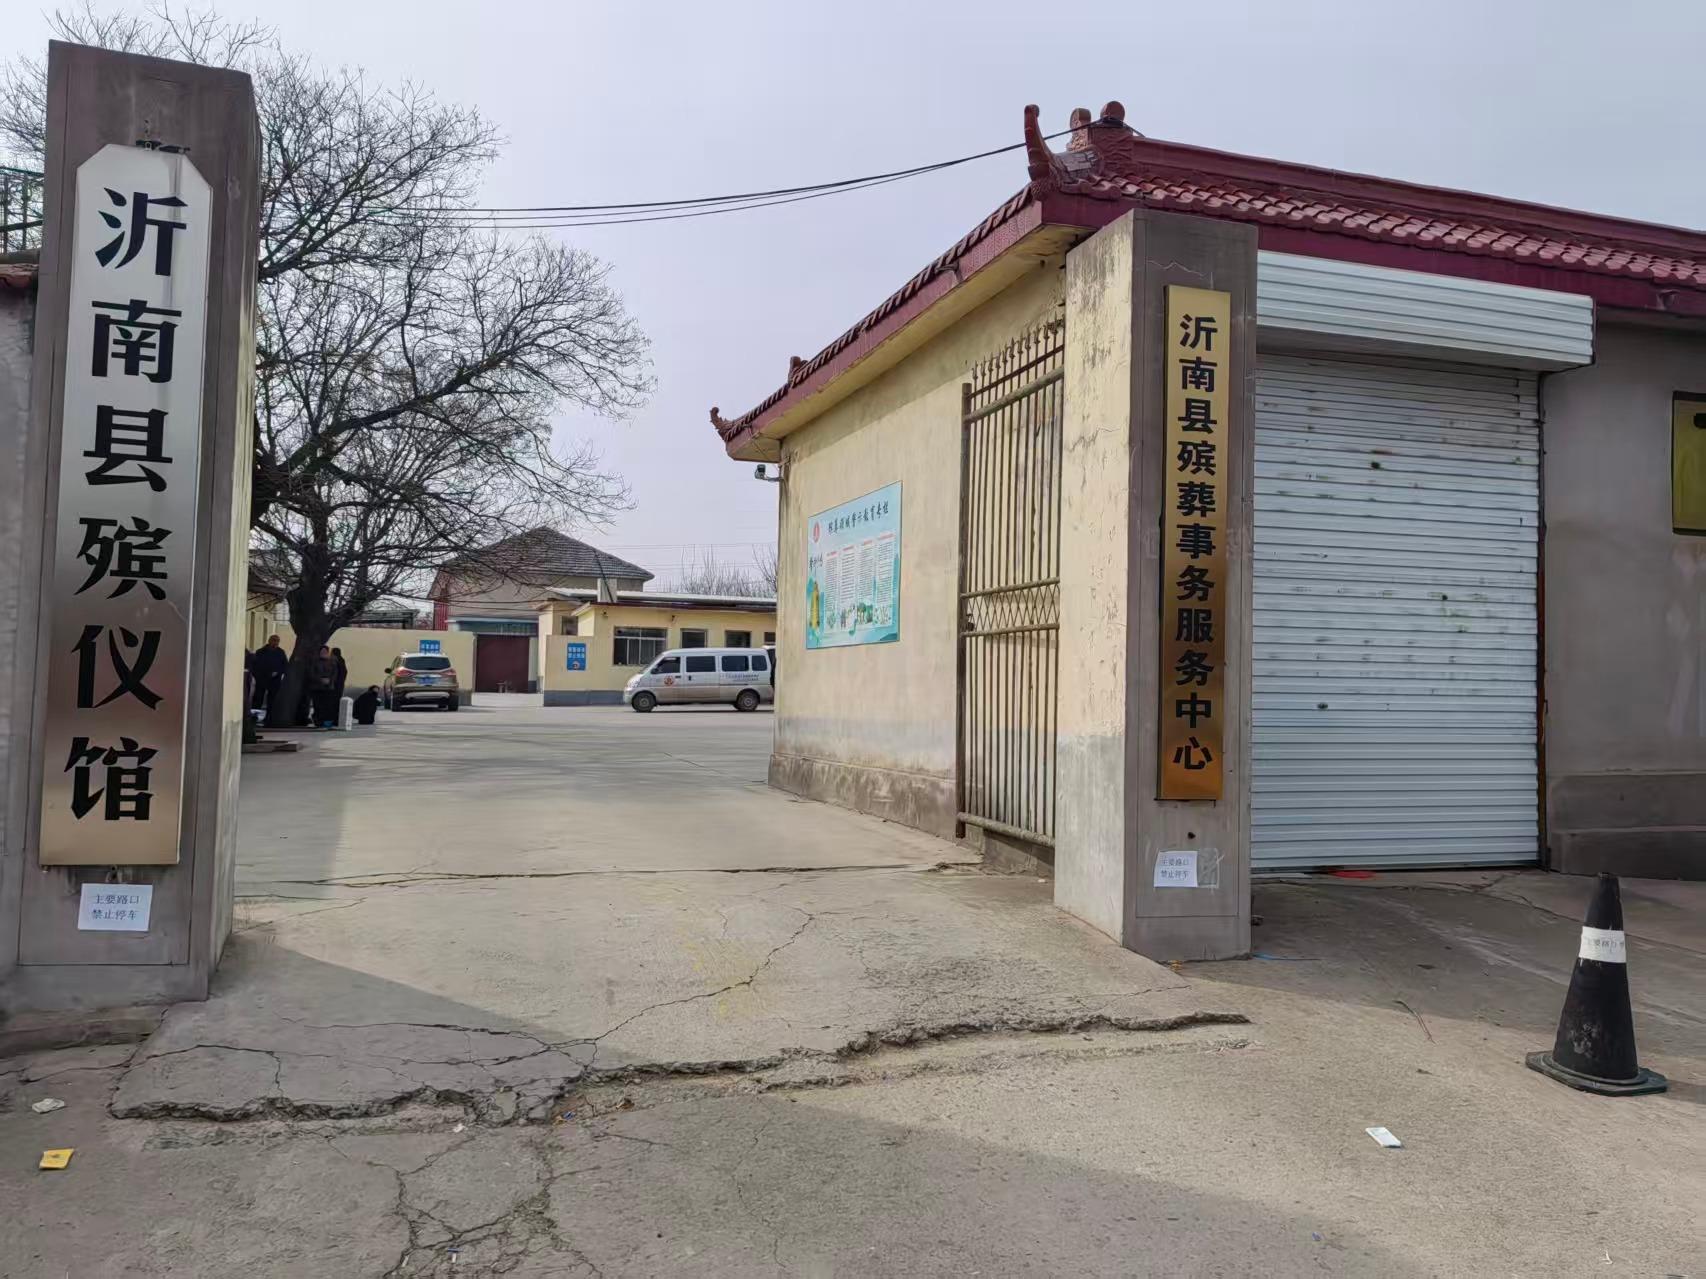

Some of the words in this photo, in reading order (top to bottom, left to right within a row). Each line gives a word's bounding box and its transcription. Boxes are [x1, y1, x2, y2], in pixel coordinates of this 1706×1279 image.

[63, 187, 187, 821] 沂南县殡仪馆
[1172, 314, 1218, 770] 沂南县殡葬事务服务中心
[91, 894, 140, 905] 主要路口
[92, 908, 138, 920] 禁止停车
